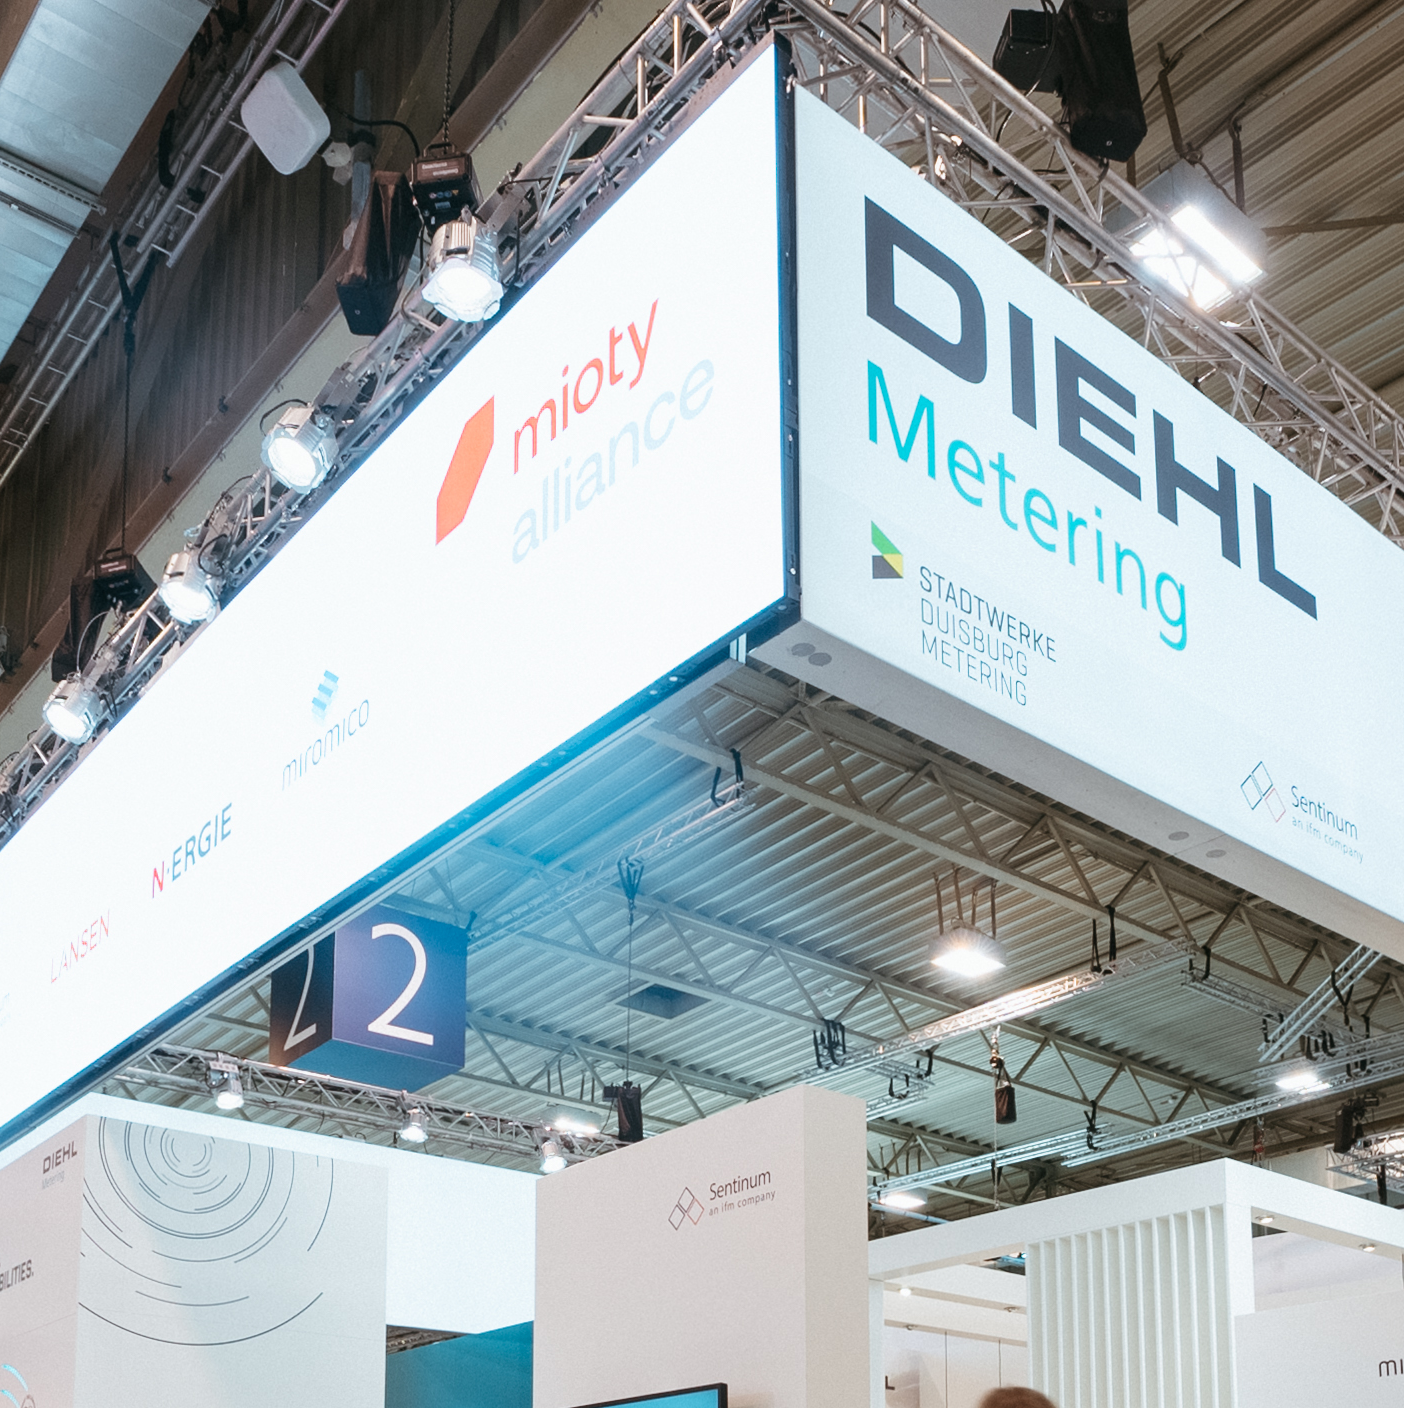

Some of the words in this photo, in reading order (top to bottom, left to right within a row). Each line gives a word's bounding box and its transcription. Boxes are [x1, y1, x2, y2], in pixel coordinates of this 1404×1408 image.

[513, 297, 659, 475] mioty
[864, 194, 1318, 621] DIEHL
[512, 358, 715, 564] alliance
[867, 359, 1188, 651] Metering
[920, 566, 1057, 663] STADTWERKE
[920, 598, 1028, 677] DUISBURG
[921, 631, 1027, 706] METERING
[281, 699, 371, 792] miromico
[1290, 785, 1358, 840] Sentinum
[1292, 816, 1304, 830] an
[1324, 834, 1364, 864] company
[50, 909, 110, 984] LANSEN
[367, 922, 434, 1046] 2
[42, 1140, 78, 1175] DIEHL
[709, 1171, 771, 1201] Sentinum
[708, 1206, 719, 1216] an
[737, 1190, 776, 1208] company
